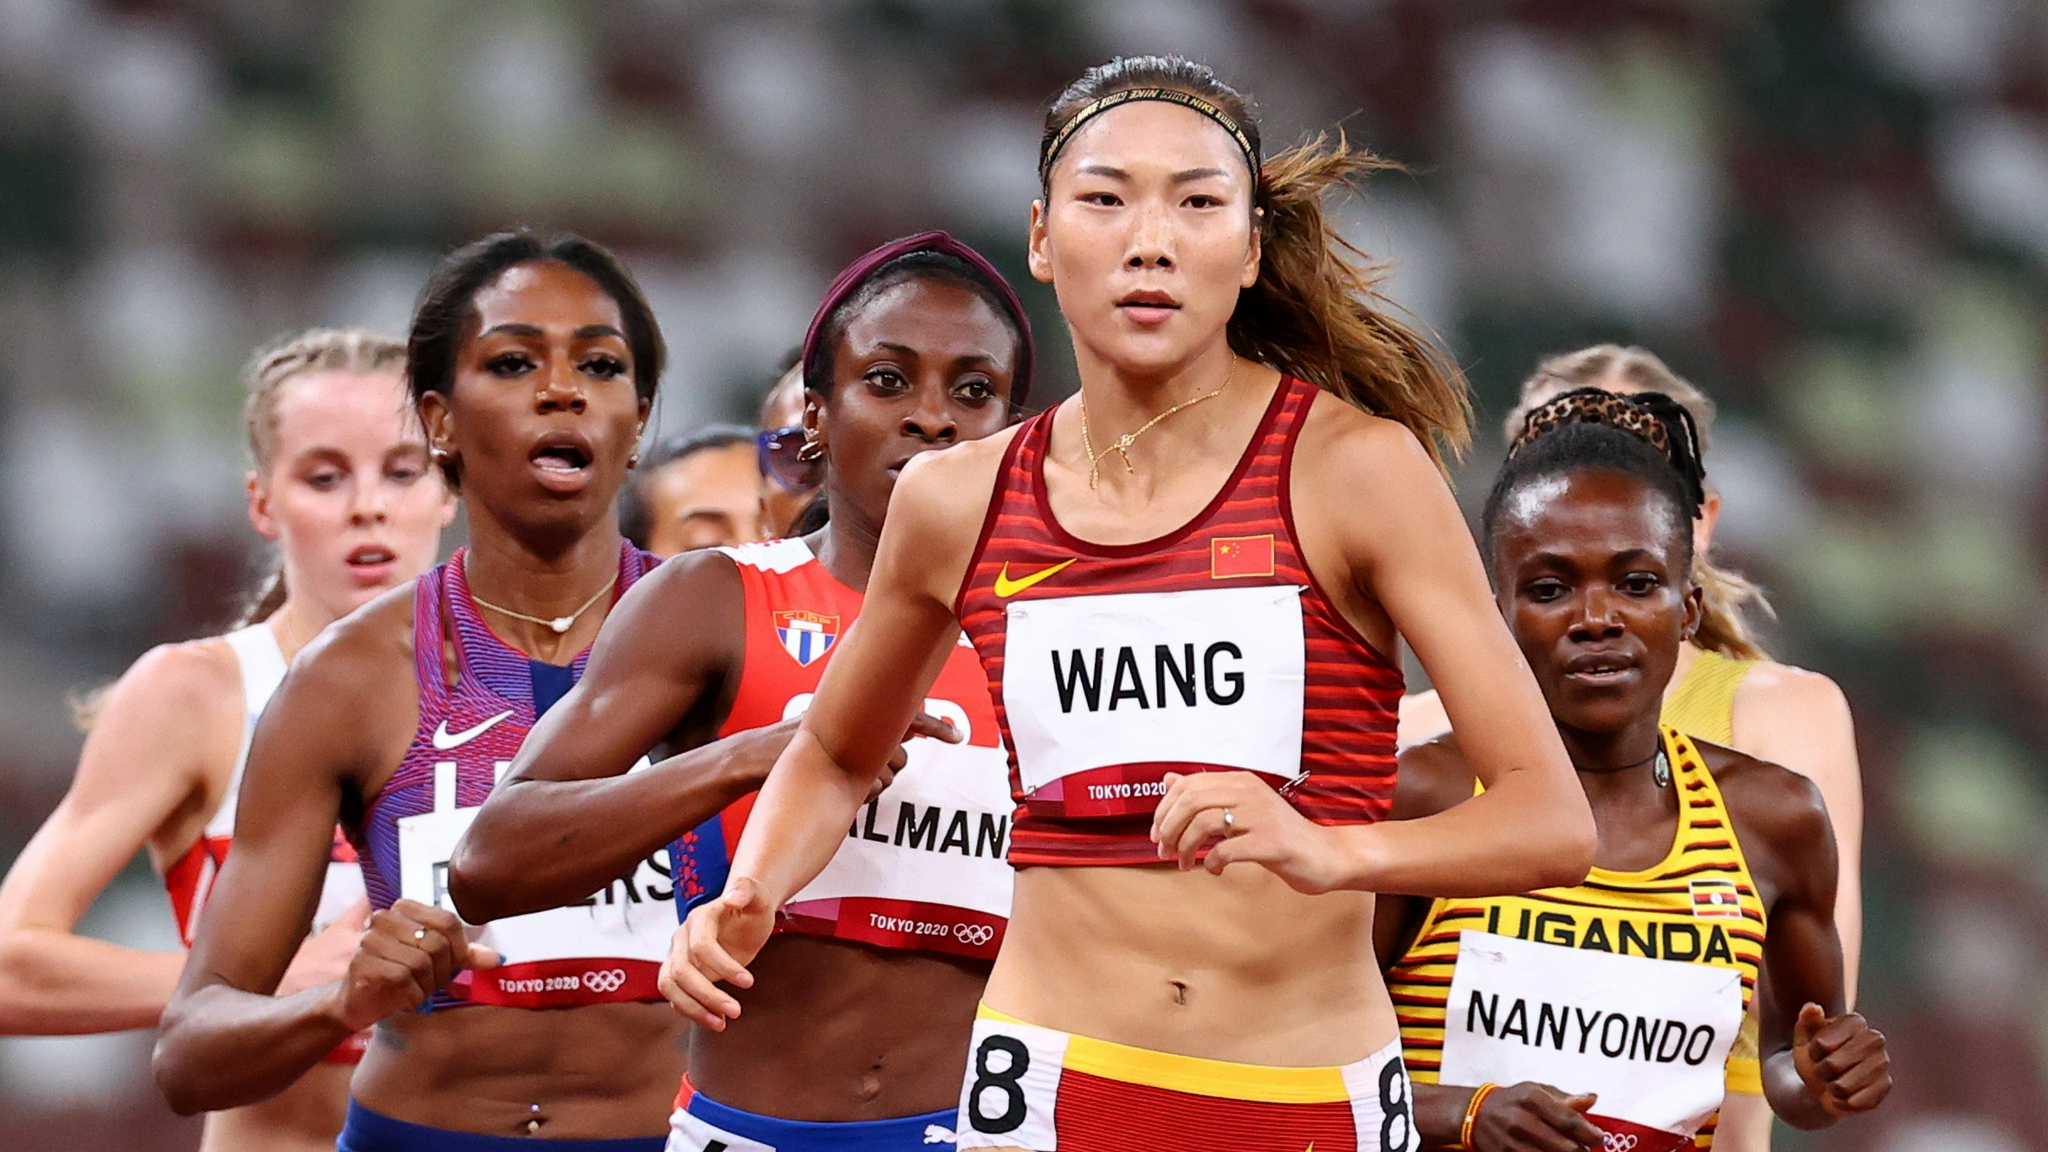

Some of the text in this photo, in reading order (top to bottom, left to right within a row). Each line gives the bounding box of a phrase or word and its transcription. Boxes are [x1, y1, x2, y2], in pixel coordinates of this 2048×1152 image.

[1129, 90, 1159, 99] NIKE
[1189, 98, 1217, 115] NIKE
[1051, 641, 1245, 713] WANG
[1087, 782, 1167, 800] TOKYO 2020
[849, 797, 1009, 860] LMAN
[869, 913, 949, 937] TOKYO 2020
[1487, 905, 1733, 964] UGANDA
[498, 976, 580, 993] TOKYO 2020
[1467, 990, 1716, 1066] NANYONDO
[968, 1034, 1030, 1134] 8
[1378, 1056, 1410, 1152] 8
